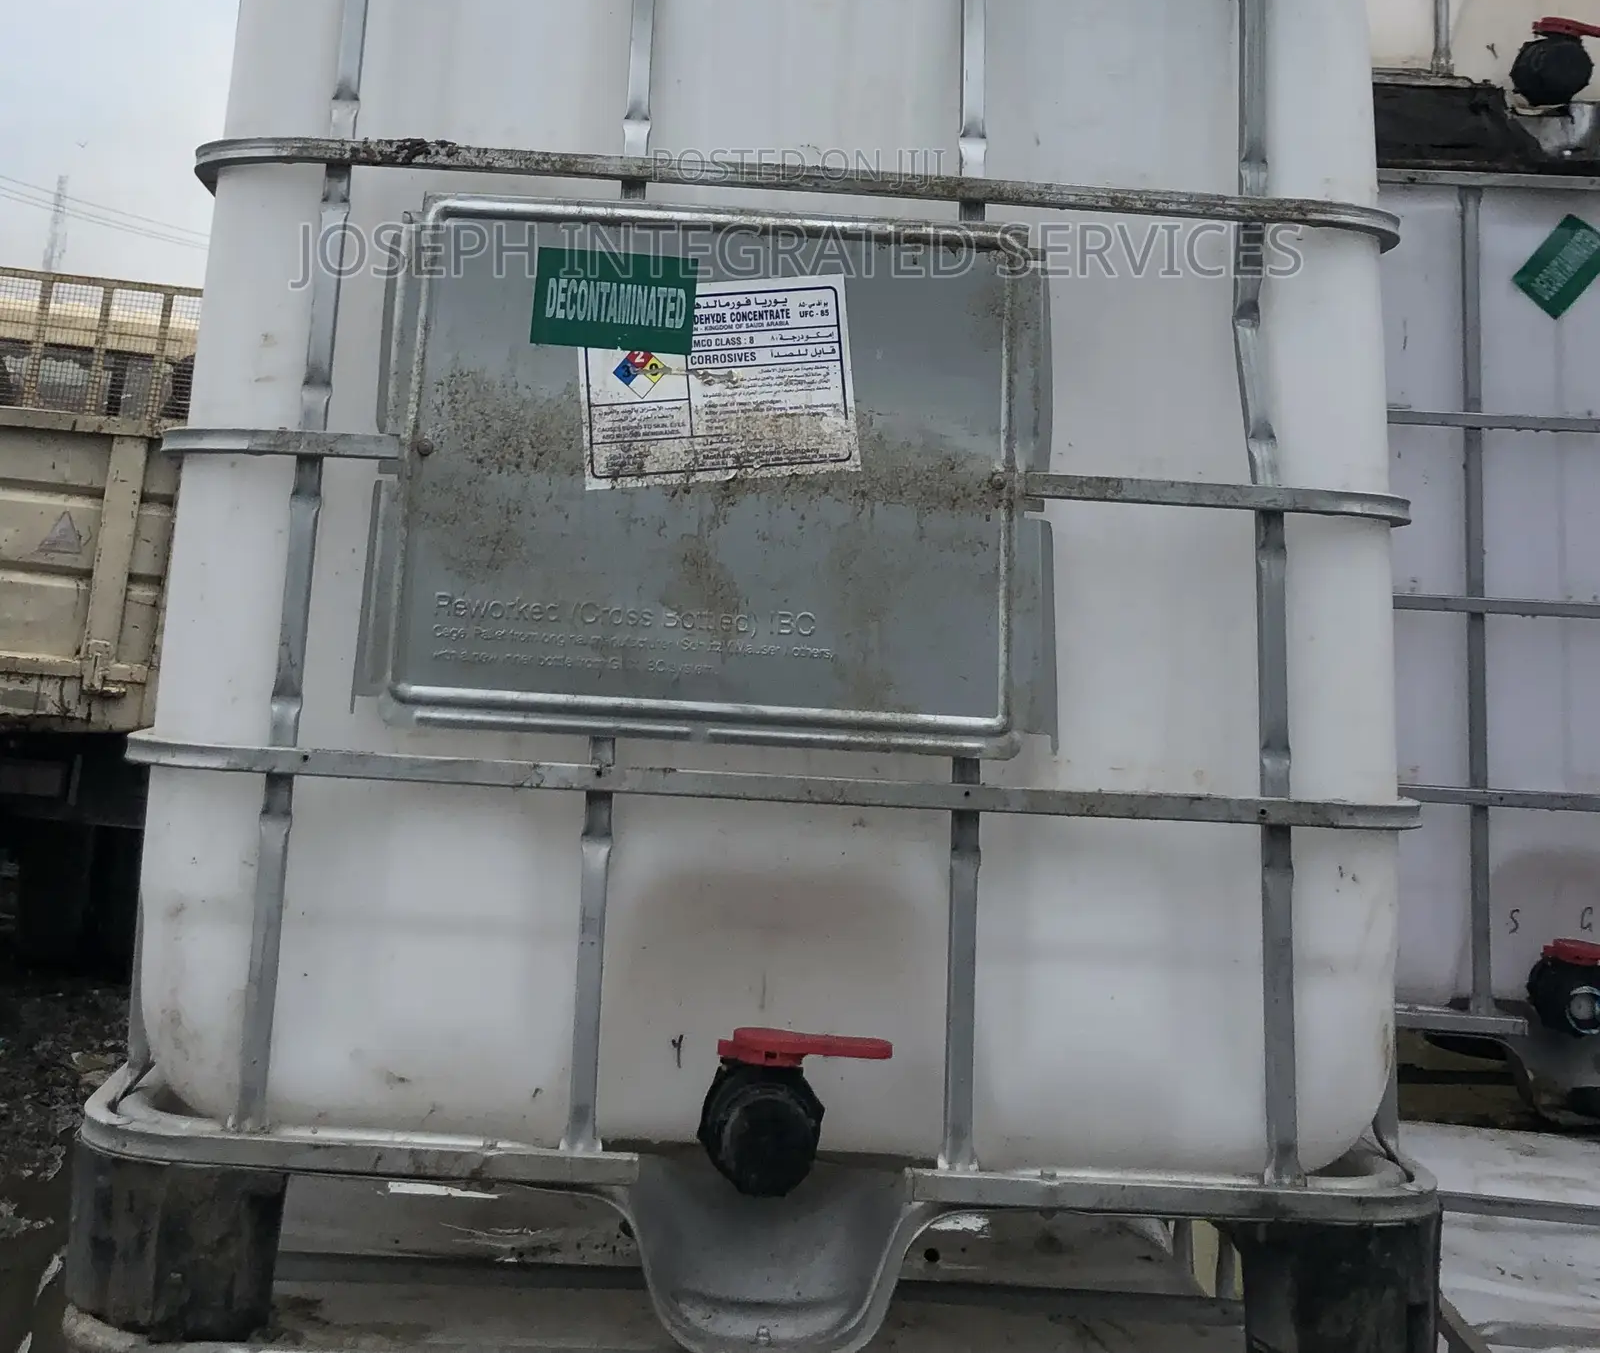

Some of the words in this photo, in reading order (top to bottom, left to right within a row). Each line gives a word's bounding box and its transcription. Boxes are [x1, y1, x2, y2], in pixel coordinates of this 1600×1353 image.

[545, 277, 687, 329] DECONTAMINATED
[694, 296, 752, 310] فورمالده
[694, 311, 727, 326] DEHYDE
[729, 308, 791, 324] CONCENTRATE
[799, 310, 815, 319] UFC
[820, 309, 830, 318] 85
[704, 323, 734, 332] KINGDOM
[766, 319, 790, 328] ARABIA
[693, 338, 713, 348] MCO
[714, 336, 742, 347] CLASS
[748, 335, 755, 345] 8
[633, 350, 645, 363] 2
[690, 351, 757, 366] CORROSIVES
[435, 591, 563, 624] Reworked
[570, 598, 654, 628] (Cross
[1508, 908, 1521, 934] S
[1580, 906, 1594, 932] G
